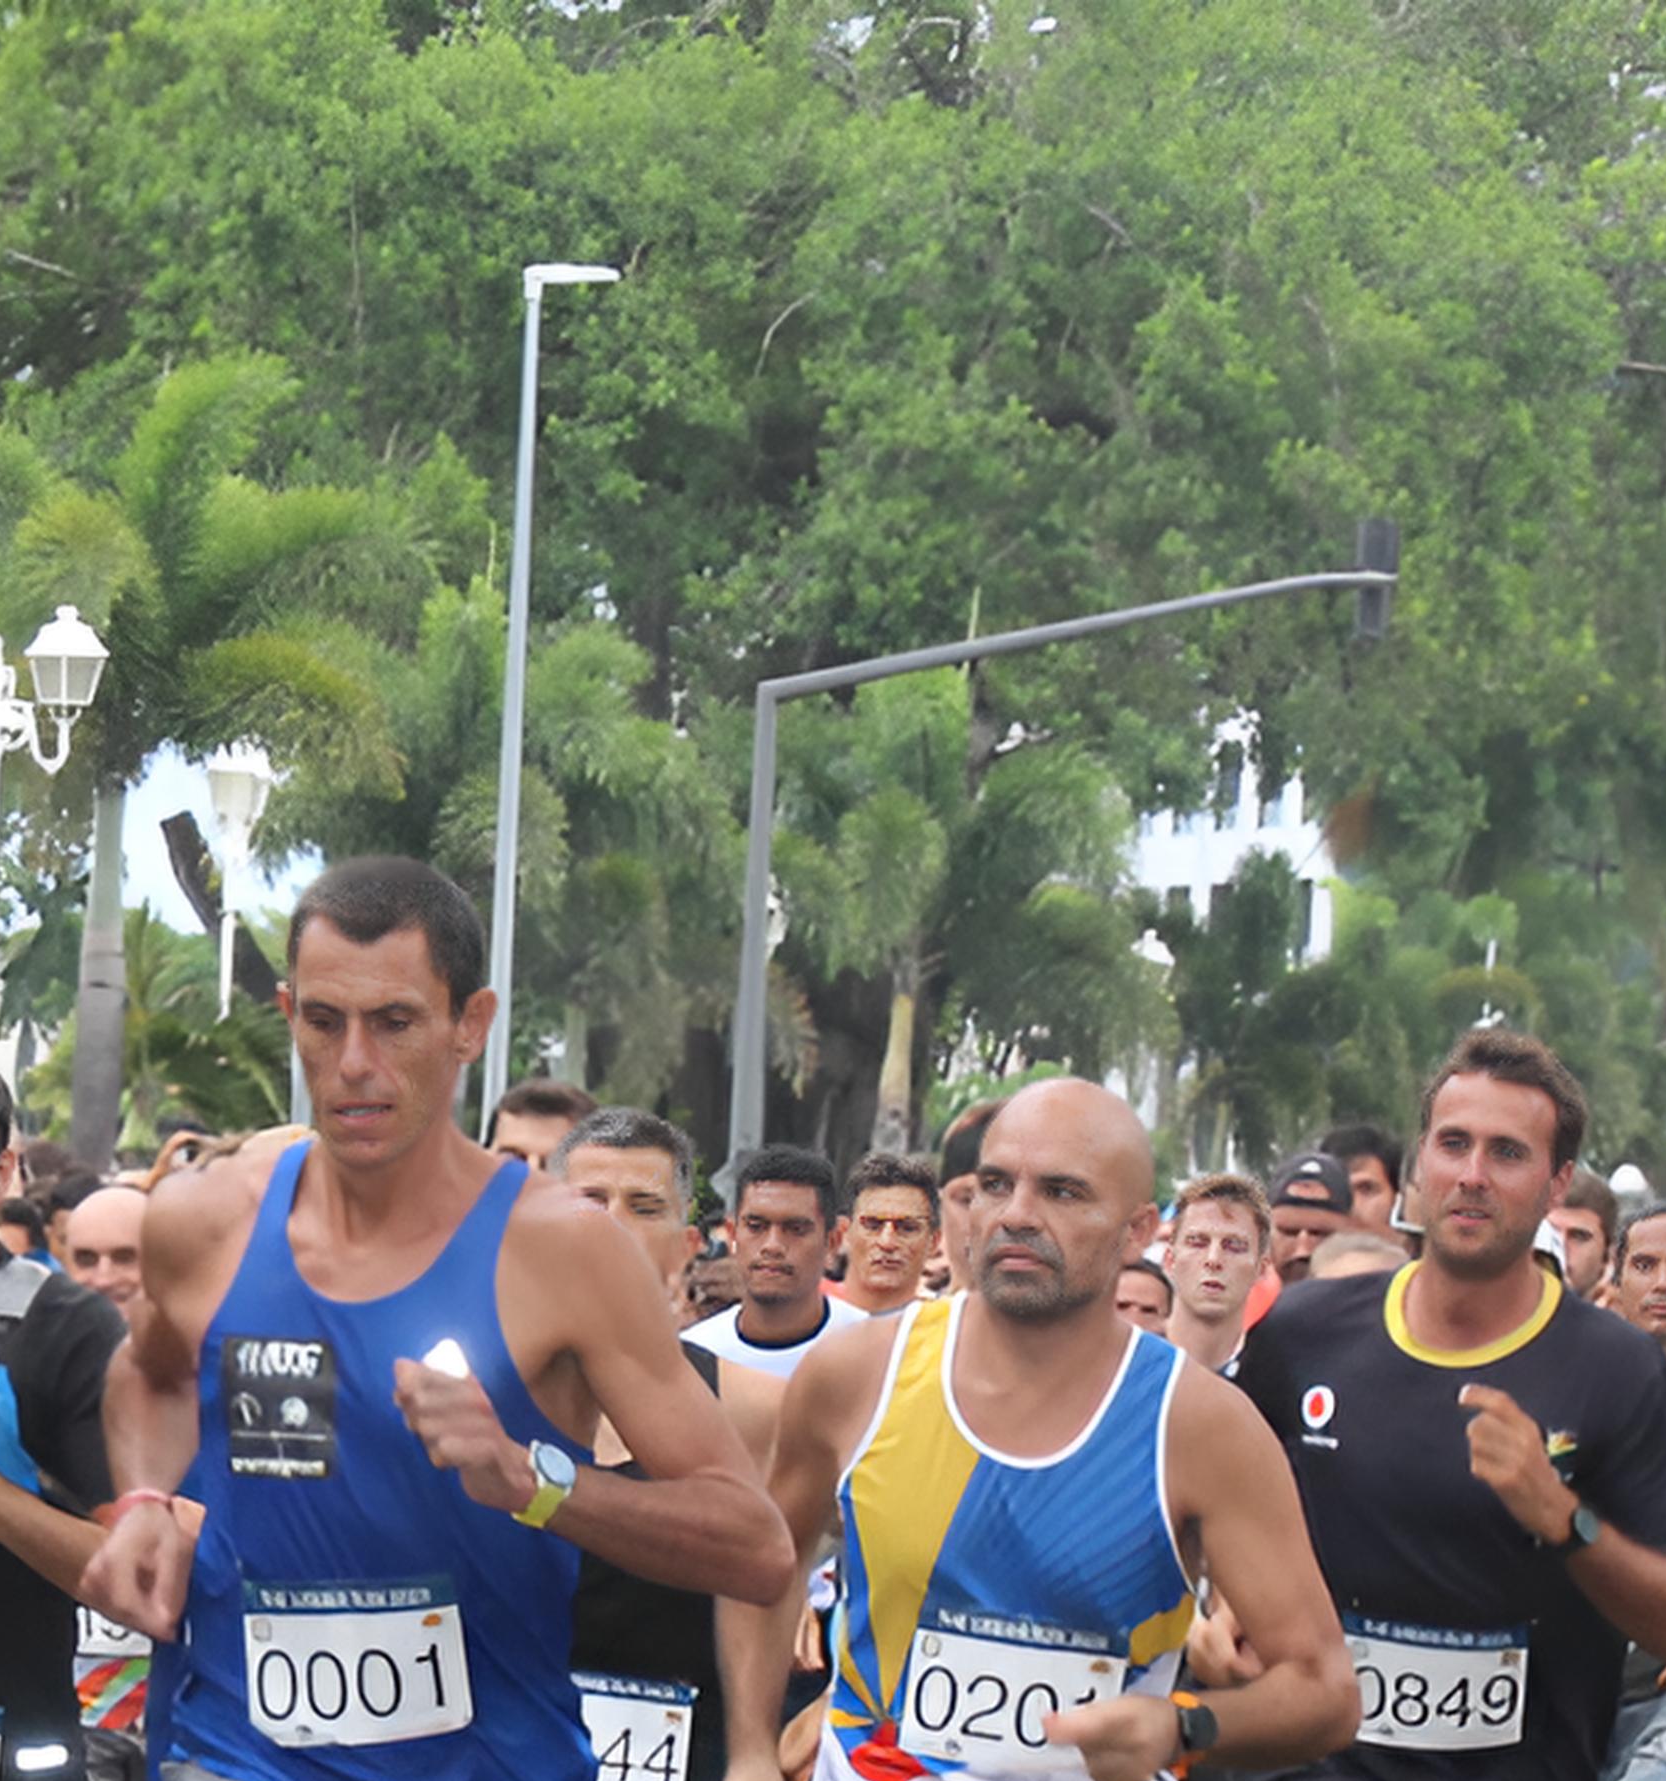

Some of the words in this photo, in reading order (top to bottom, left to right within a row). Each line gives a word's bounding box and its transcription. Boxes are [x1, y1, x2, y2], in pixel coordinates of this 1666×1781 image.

[257, 1643, 445, 1720] 0001
[914, 1664, 1096, 1748] 020
[1355, 1665, 1519, 1726] 0849
